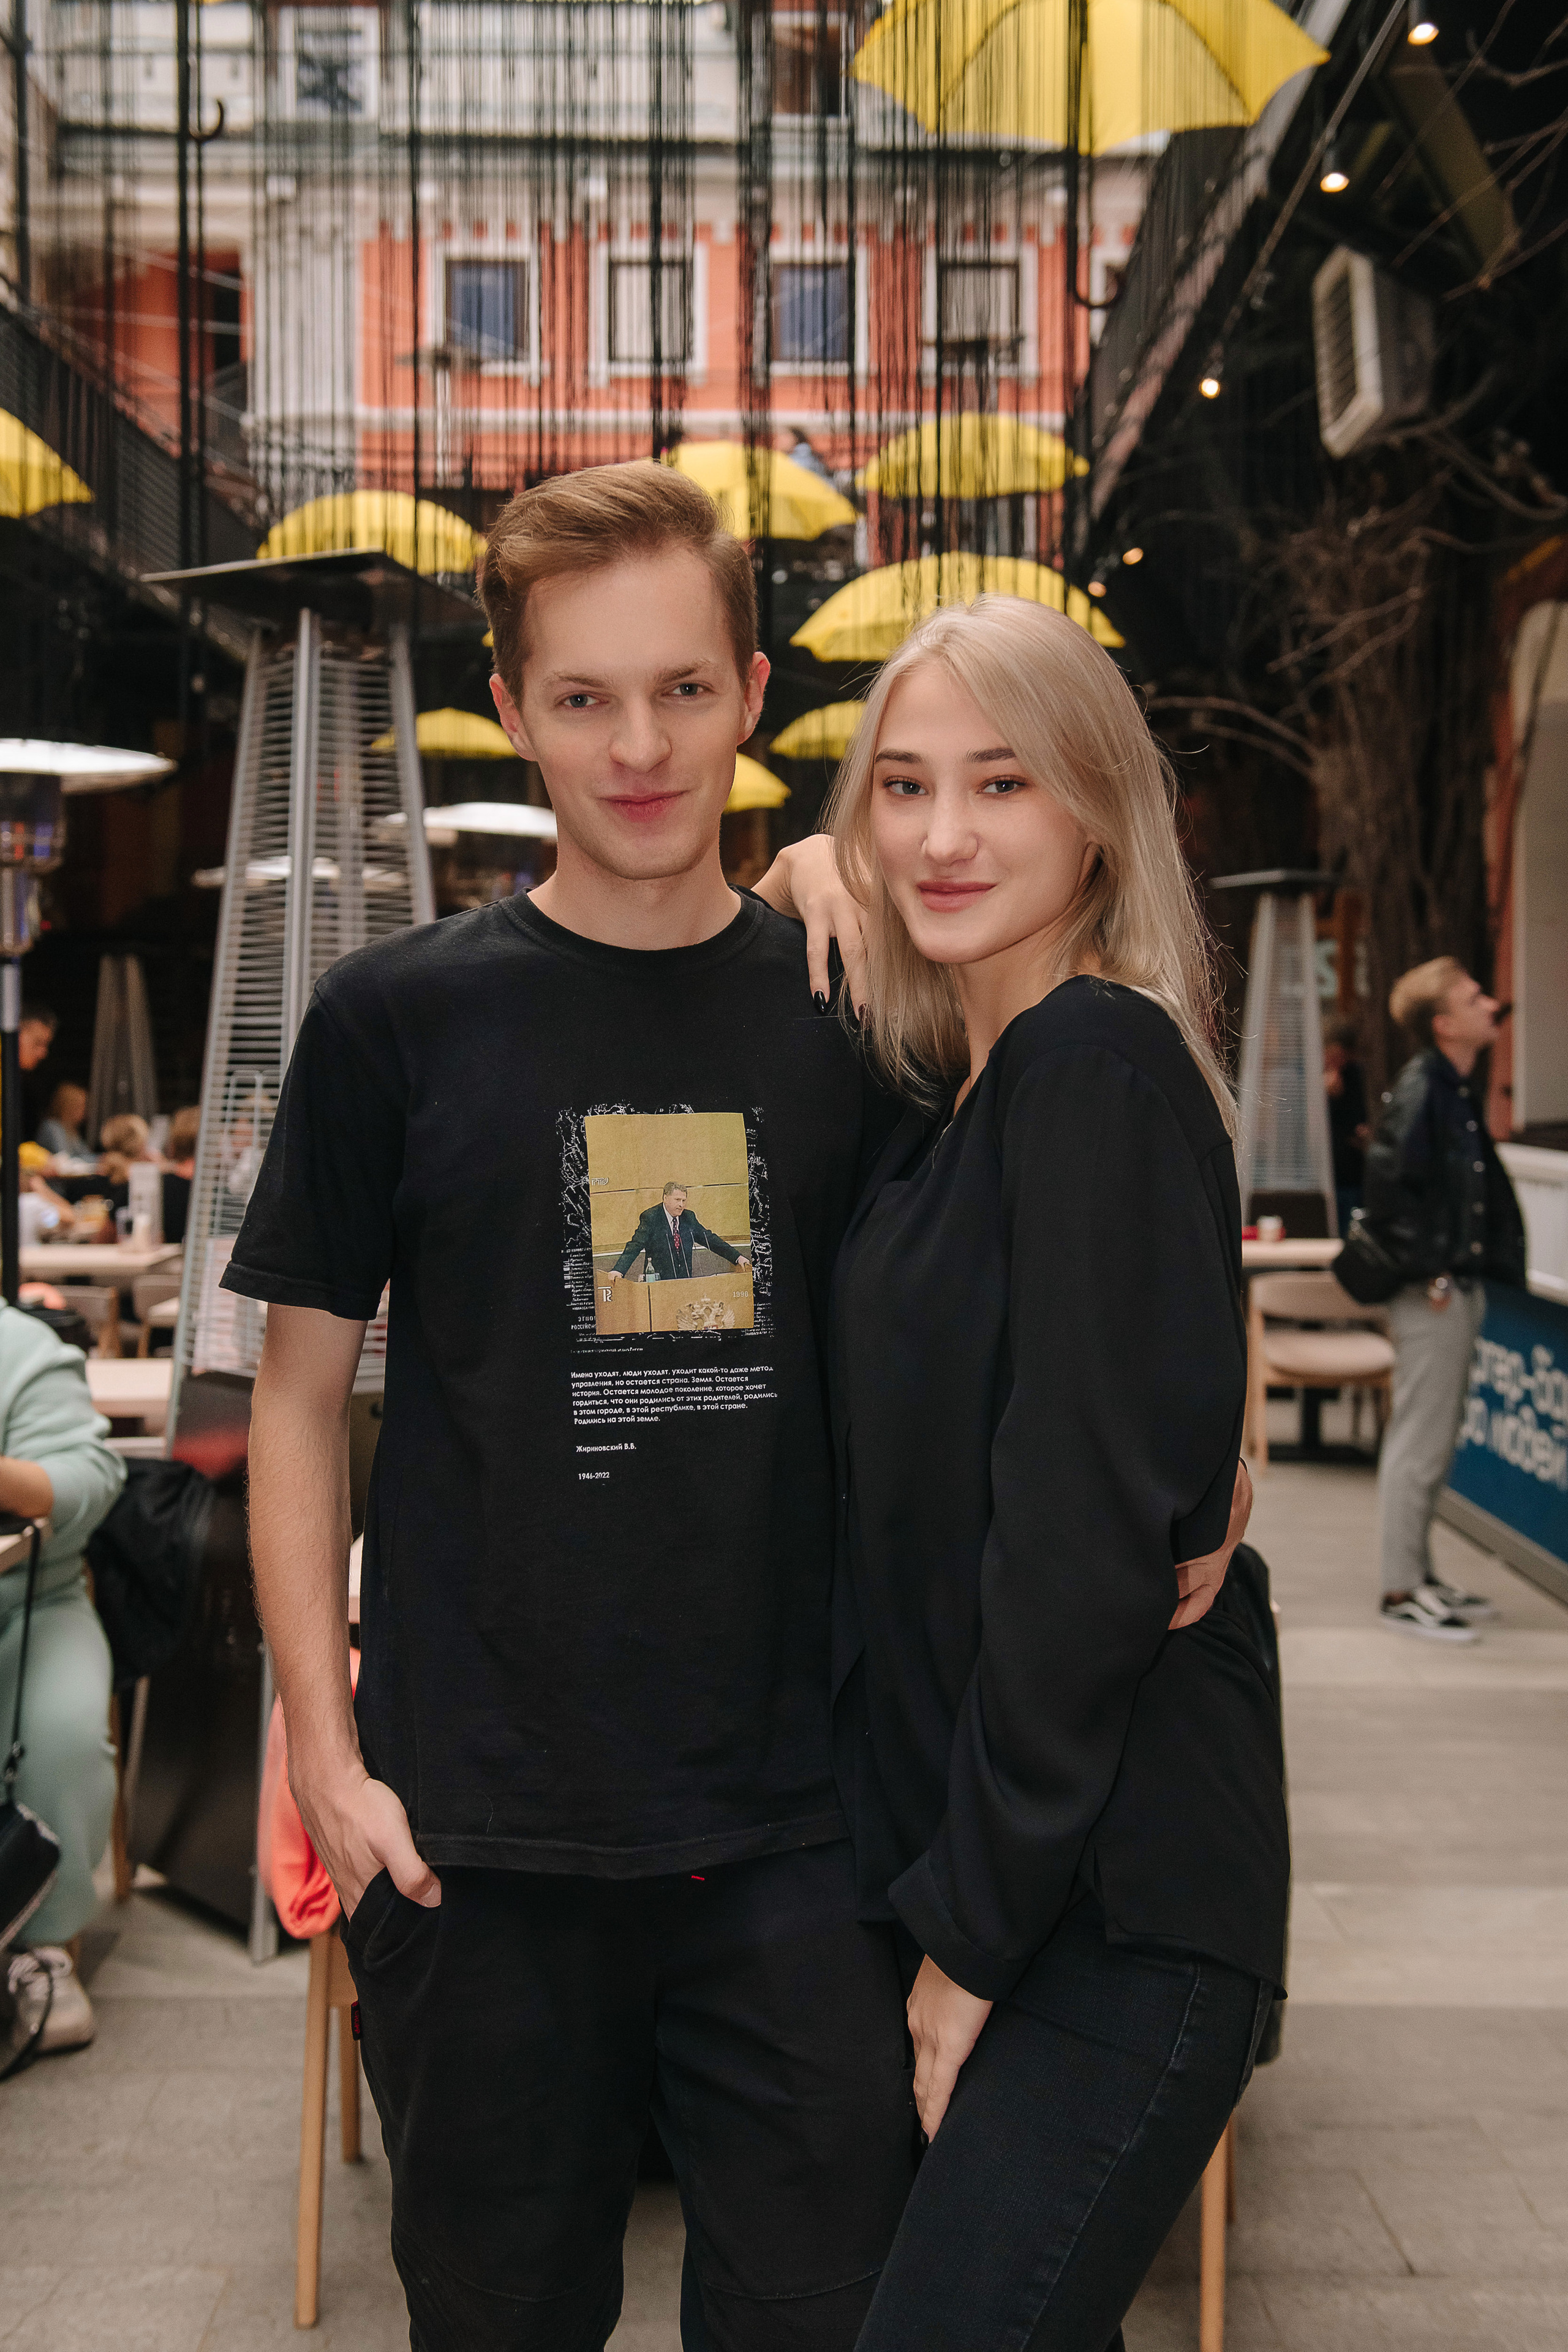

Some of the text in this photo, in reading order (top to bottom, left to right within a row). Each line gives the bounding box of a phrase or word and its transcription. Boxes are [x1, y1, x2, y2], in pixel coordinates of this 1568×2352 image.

[571, 1381, 614, 1389] управления,
[703, 1393, 742, 1402] родителей,
[744, 1392, 777, 1401] родились
[650, 1404, 695, 1414] республике,
[576, 1443, 623, 1453] Жириновский
